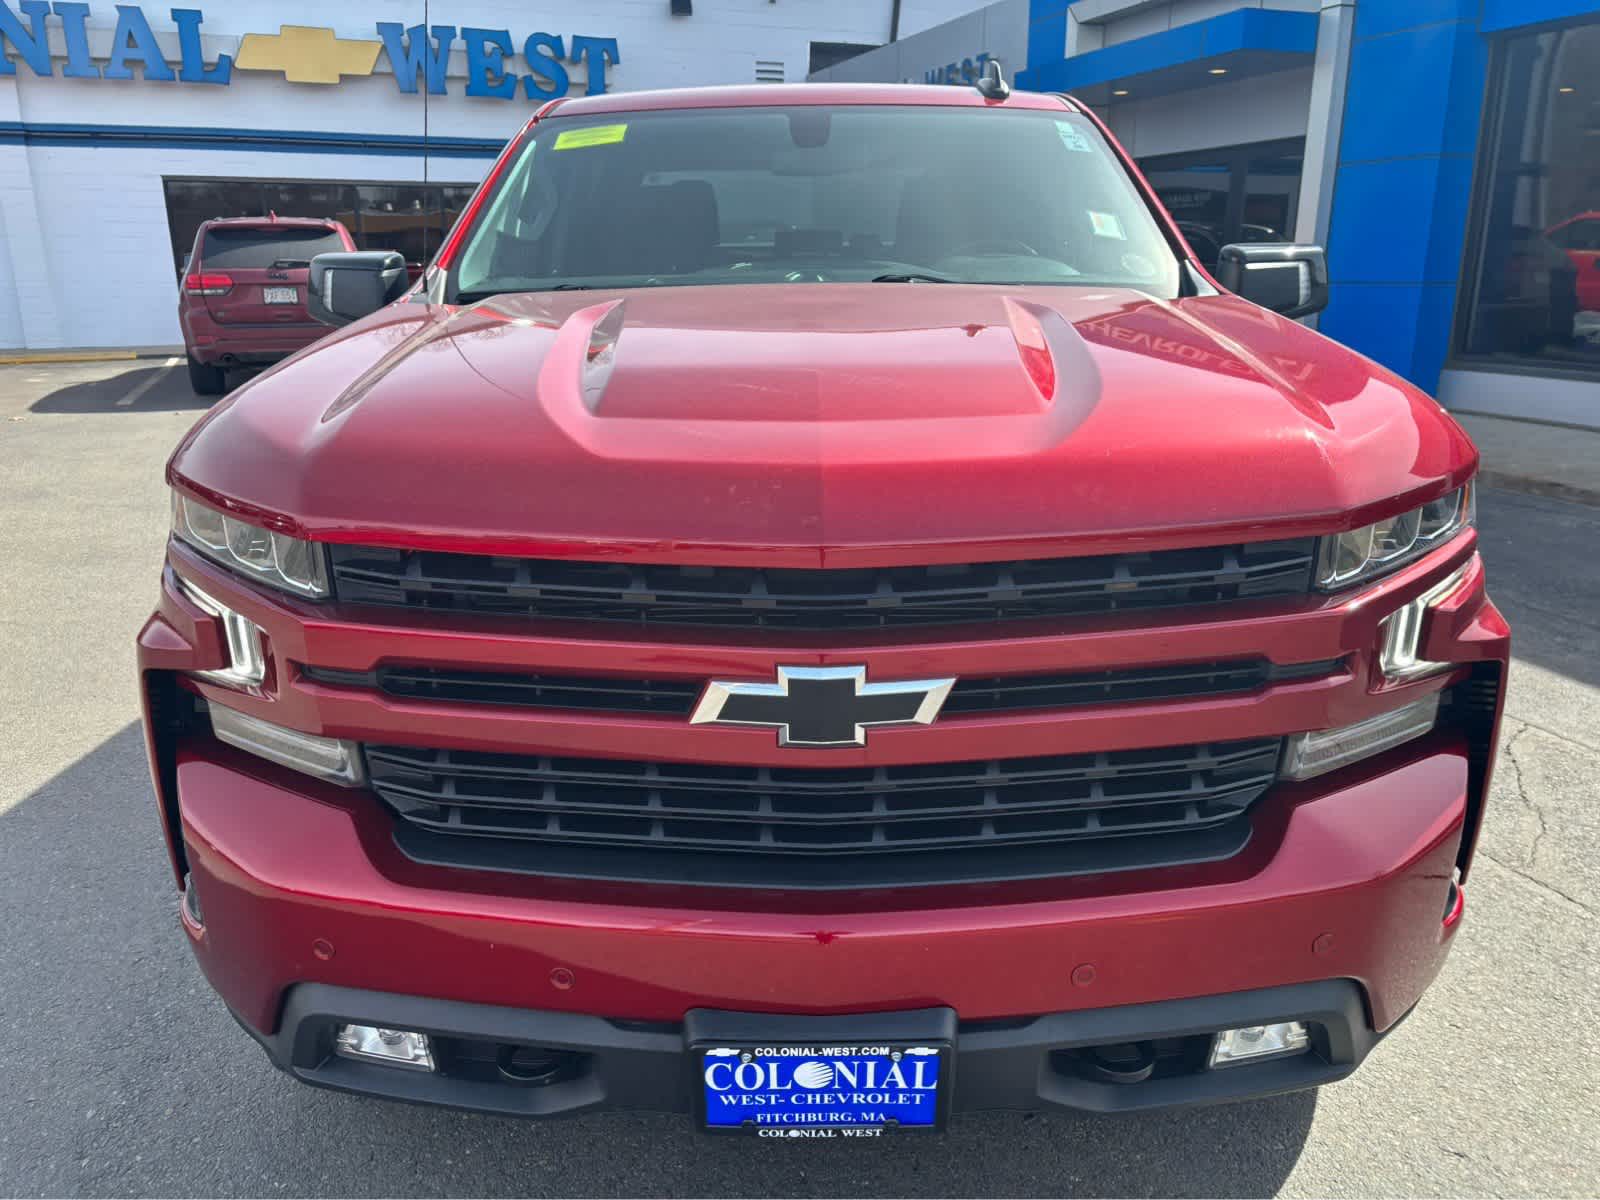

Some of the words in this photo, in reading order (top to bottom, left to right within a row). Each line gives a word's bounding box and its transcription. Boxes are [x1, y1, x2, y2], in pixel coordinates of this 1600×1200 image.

[0, 0, 232, 86] NIAL
[376, 22, 620, 101] WEST
[754, 1047, 890, 1057] COLONIAL-WEST.COM
[704, 1060, 938, 1091] COLONIAL
[790, 1092, 925, 1105] CHEVROLET
[756, 1111, 857, 1123] FITCHBURG,
[861, 1112, 887, 1122] MA
[758, 1129, 837, 1138] COLONIAL
[841, 1128, 884, 1137] WEST
